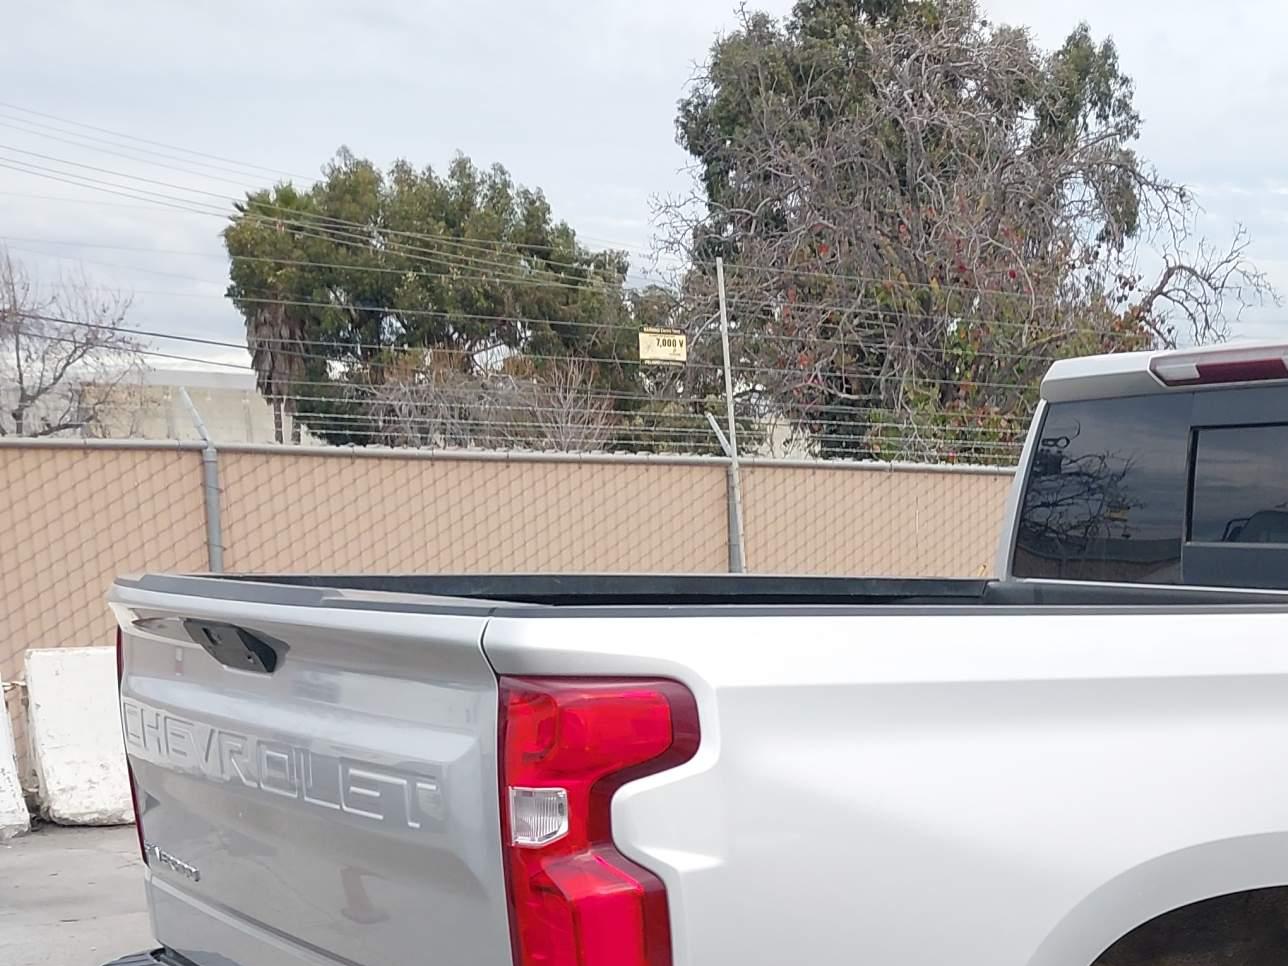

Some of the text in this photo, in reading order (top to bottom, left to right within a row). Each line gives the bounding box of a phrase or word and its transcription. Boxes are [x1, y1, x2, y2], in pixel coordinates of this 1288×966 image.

[656, 338, 684, 348] 7,000 V
[122, 700, 438, 829] CHEVROLET
